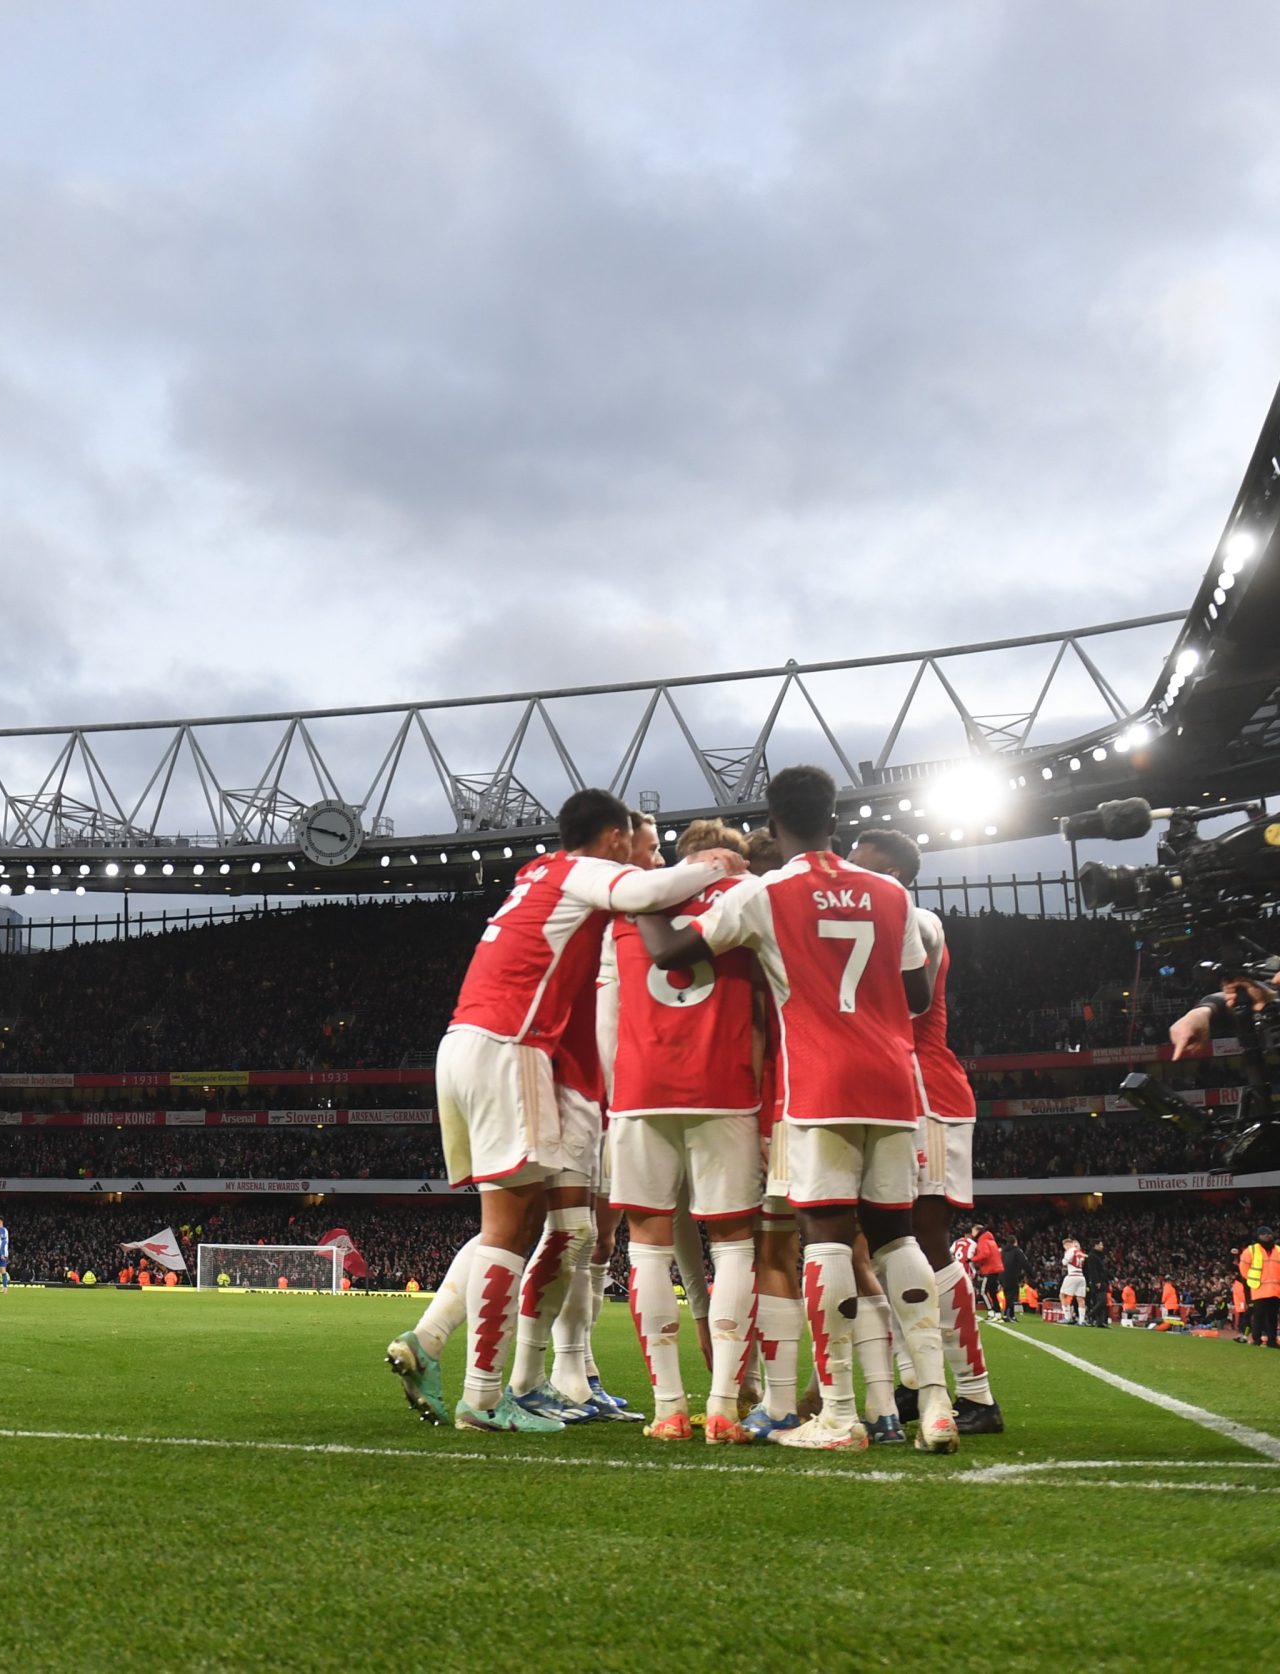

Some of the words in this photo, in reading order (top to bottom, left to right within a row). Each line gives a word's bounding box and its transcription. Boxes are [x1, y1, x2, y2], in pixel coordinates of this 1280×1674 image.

[812, 889, 872, 911] SAKA
[818, 919, 875, 1013] 7
[133, 1075, 159, 1085] 1931
[322, 1072, 348, 1083] 1933
[86, 1112, 113, 1124] HONG
[125, 1112, 151, 1124] KONG
[220, 1112, 256, 1123] Arsenal
[286, 1111, 335, 1123] Slovenia
[350, 1111, 384, 1122] ARSENAL
[393, 1111, 430, 1122] GERMANY
[225, 1182, 235, 1190] MY
[237, 1182, 266, 1190] ARSENAL
[268, 1182, 300, 1190] REWARDS
[1138, 1177, 1188, 1190] Emirates
[1192, 1176, 1204, 1187] FLY
[1206, 1174, 1233, 1188] BETTER
[955, 1246, 964, 1260] 6
